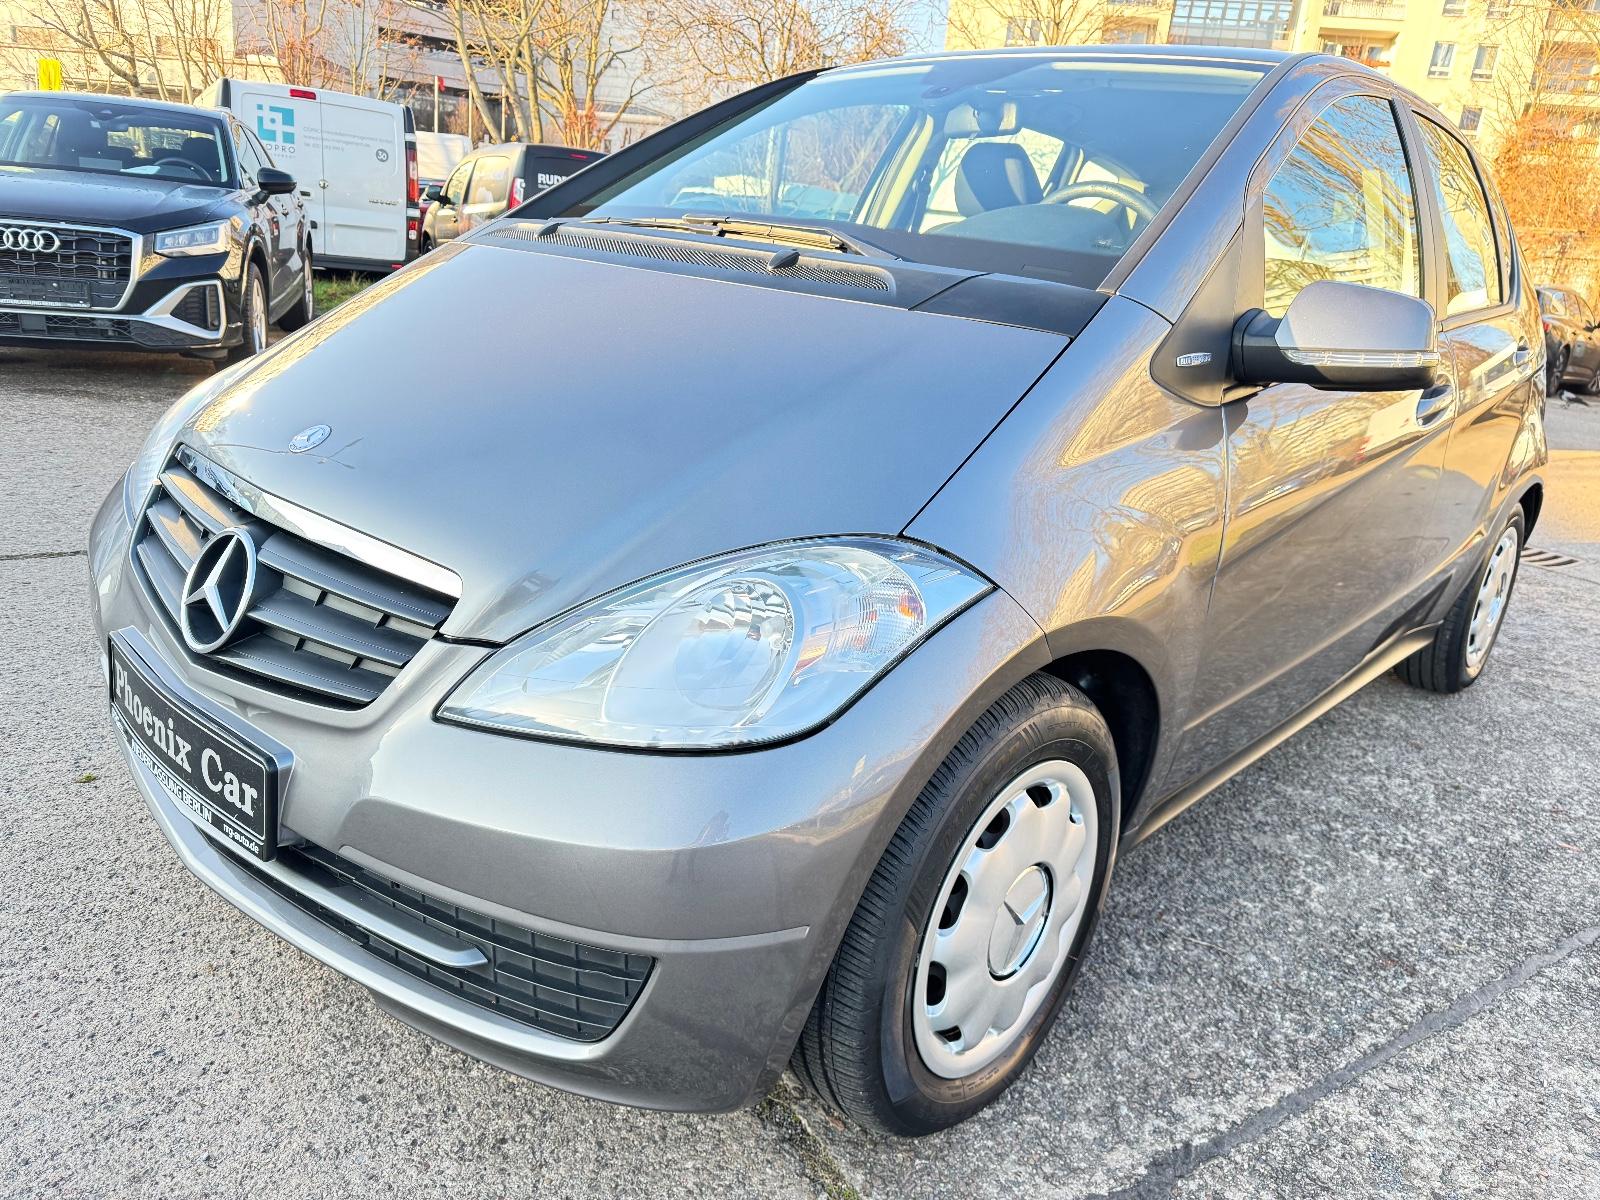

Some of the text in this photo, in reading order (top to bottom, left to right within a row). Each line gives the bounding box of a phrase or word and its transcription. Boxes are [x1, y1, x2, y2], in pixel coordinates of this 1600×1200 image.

[265, 144, 296, 153] OPRO
[115, 660, 258, 817] Phoenix Car
[182, 789, 212, 824] BERLIN
